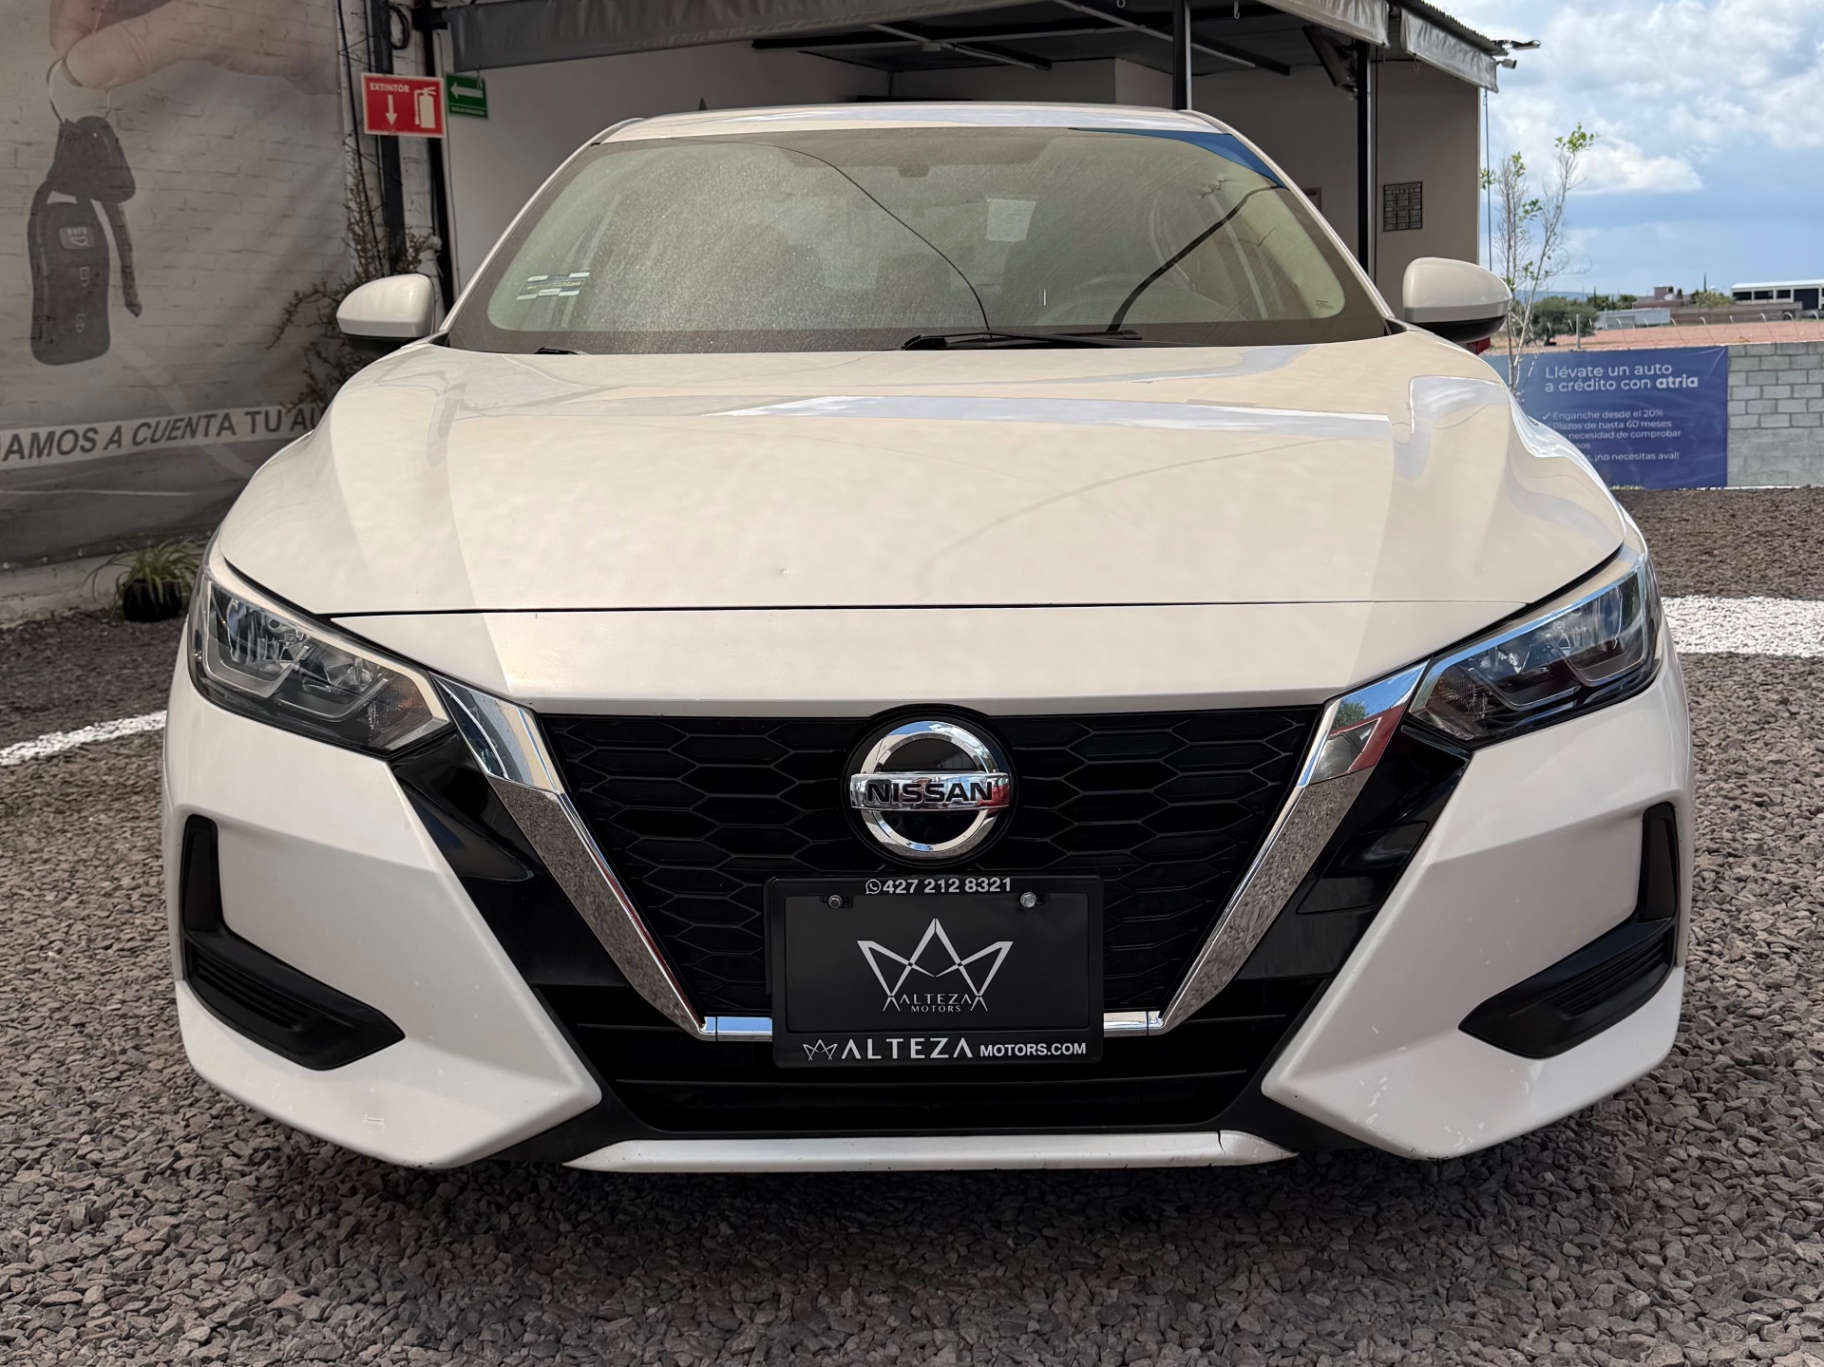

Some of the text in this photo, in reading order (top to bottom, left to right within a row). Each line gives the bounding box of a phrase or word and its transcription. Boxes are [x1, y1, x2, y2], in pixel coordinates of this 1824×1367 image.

[369, 82, 410, 93] EXTINTOR
[1545, 363, 1672, 379] Llévate un auto
[1545, 374, 1698, 393] a crédito con atria
[1552, 409, 1664, 421] Enganche desde el 20%
[1584, 421, 1597, 430] de
[1598, 420, 1625, 429] hasta
[1626, 420, 1639, 428] 60
[1640, 419, 1672, 428] meses
[1, 427, 99, 462] AMOS
[103, 425, 123, 451] A
[132, 412, 237, 447] CUENTA
[244, 408, 283, 434] TU
[1568, 431, 1614, 439] necesidad
[1616, 430, 1629, 438] de
[1630, 430, 1682, 439] comprobar
[1611, 452, 1656, 461] necesitas
[1657, 450, 1681, 460] aval!
[866, 781, 994, 803] NISSAN
[882, 877, 1012, 894] 427 212 8321
[899, 993, 972, 1005] ALTEZA
[910, 1004, 962, 1013] MOTORS
[841, 1037, 1087, 1060] ALTEZA MOTORS.COM
